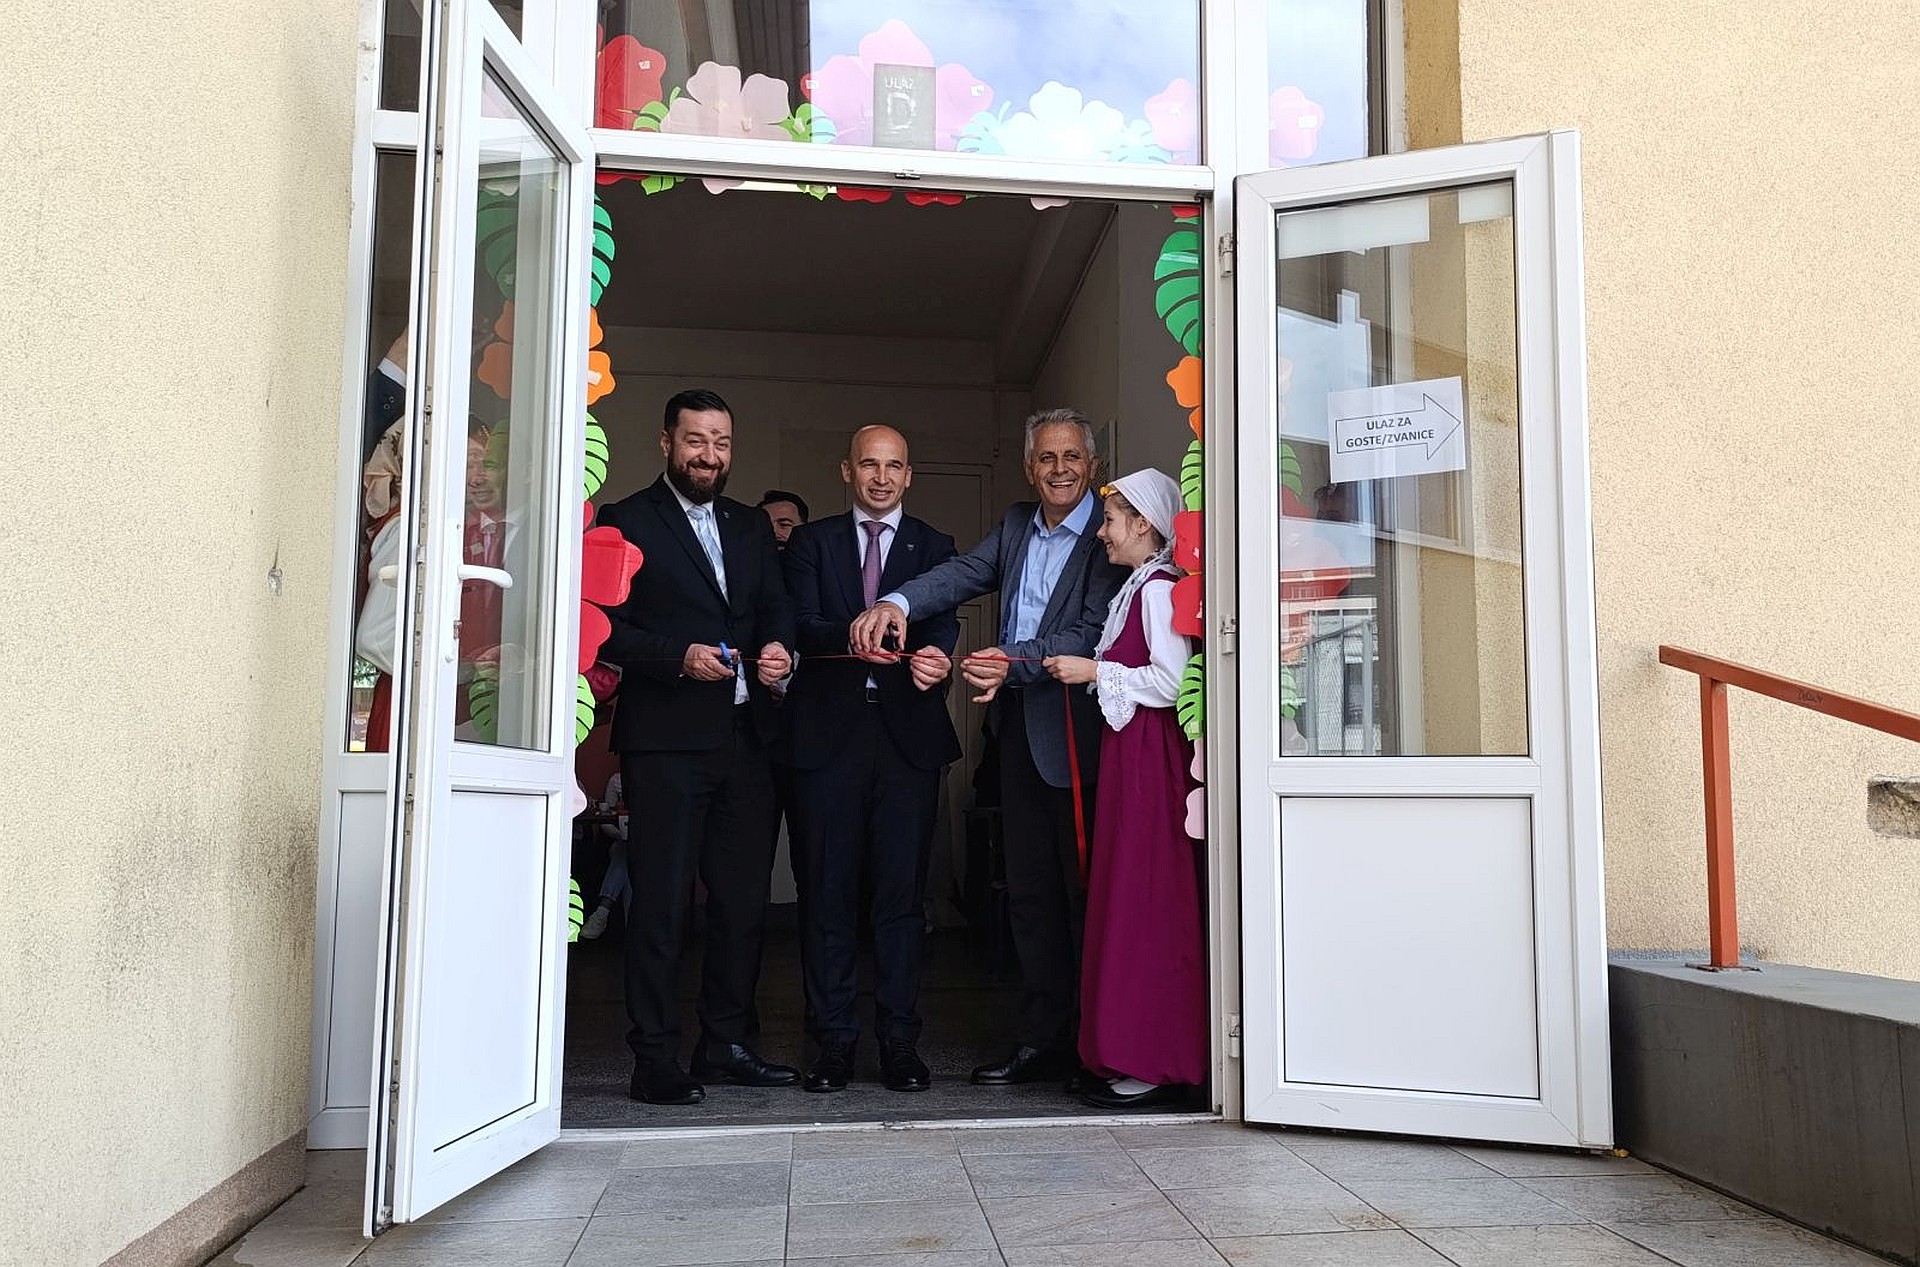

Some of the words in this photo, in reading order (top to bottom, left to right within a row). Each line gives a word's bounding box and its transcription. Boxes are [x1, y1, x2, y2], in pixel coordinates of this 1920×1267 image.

[884, 76, 914, 90] ULAZ
[1366, 417, 1395, 431] ULAZ
[1397, 416, 1412, 428] ZA
[1345, 428, 1435, 448] GOSTE/ZVANICE
